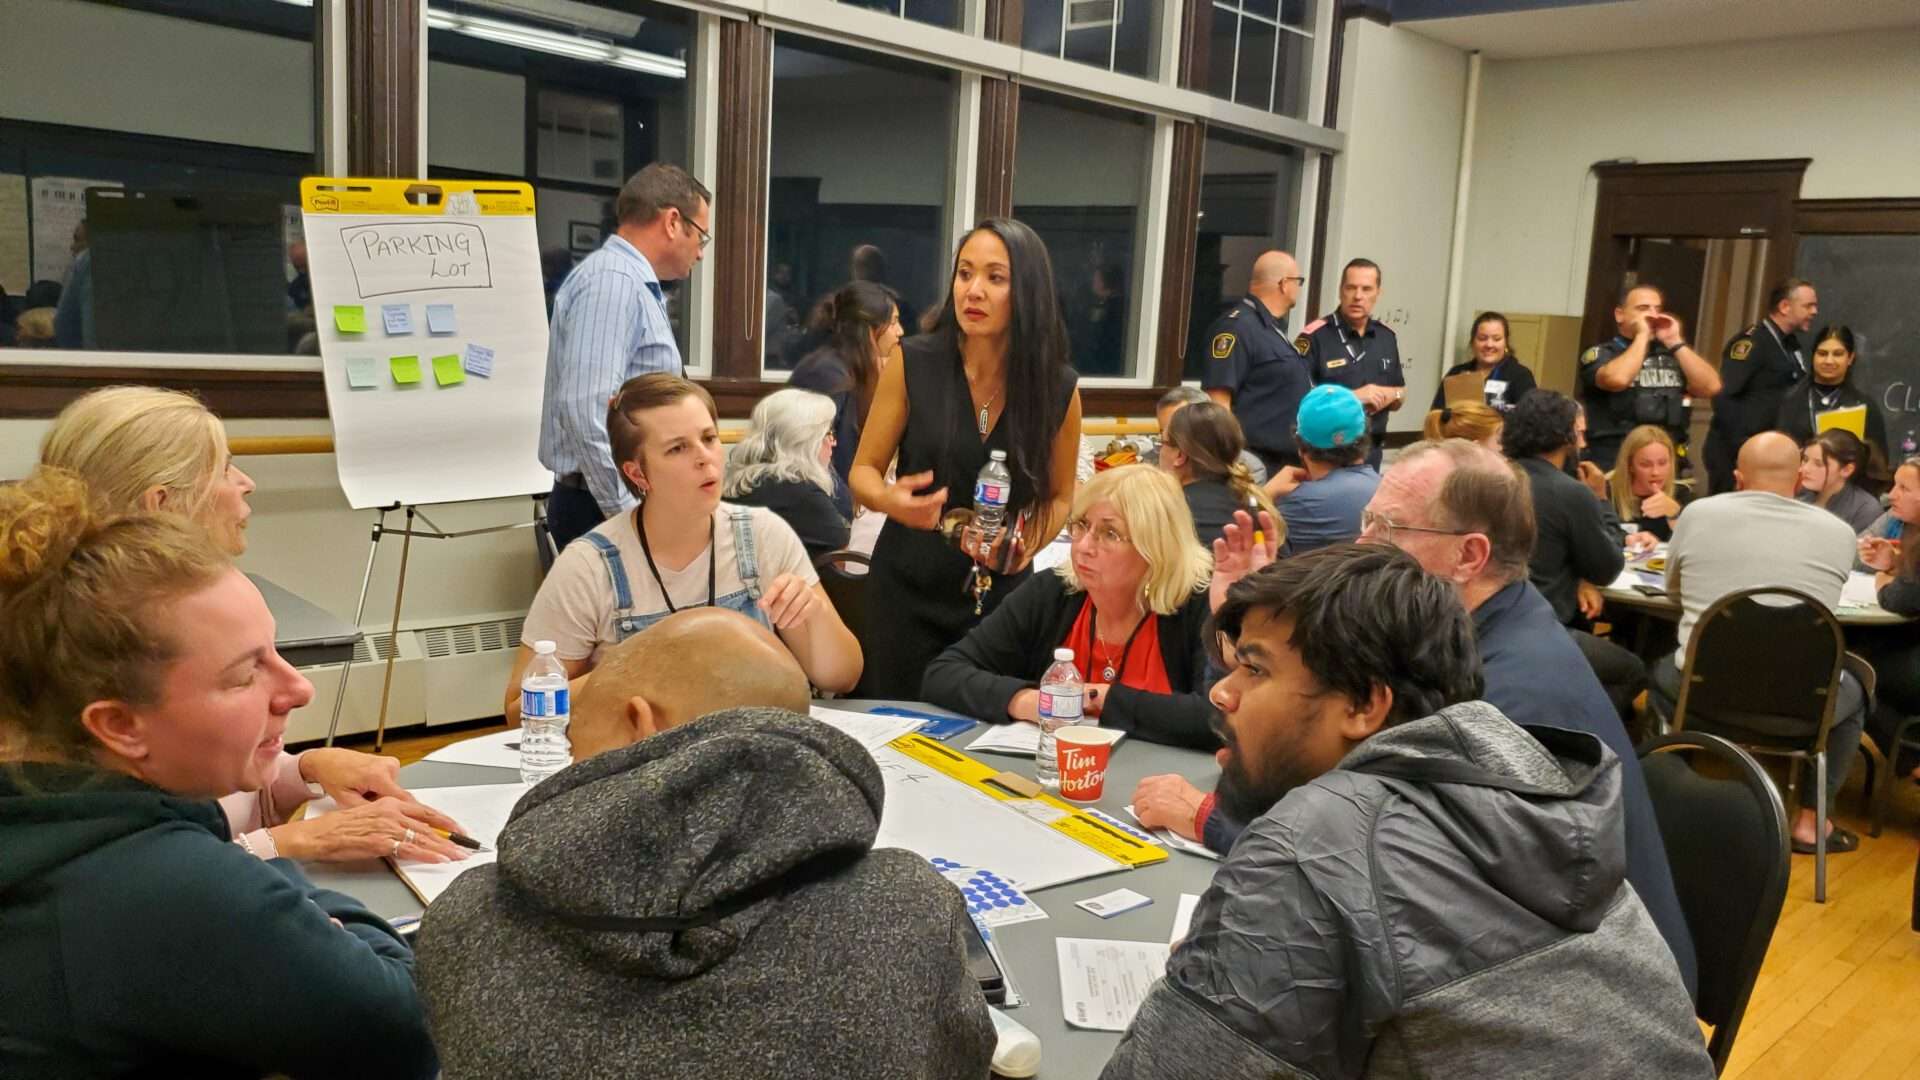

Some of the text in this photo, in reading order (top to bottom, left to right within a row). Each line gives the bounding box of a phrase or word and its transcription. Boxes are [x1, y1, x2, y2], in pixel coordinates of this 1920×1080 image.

[349, 230, 471, 260] PARKING
[430, 258, 471, 278] LOT
[1883, 381, 1920, 412] CL
[1062, 748, 1096, 770] Tim
